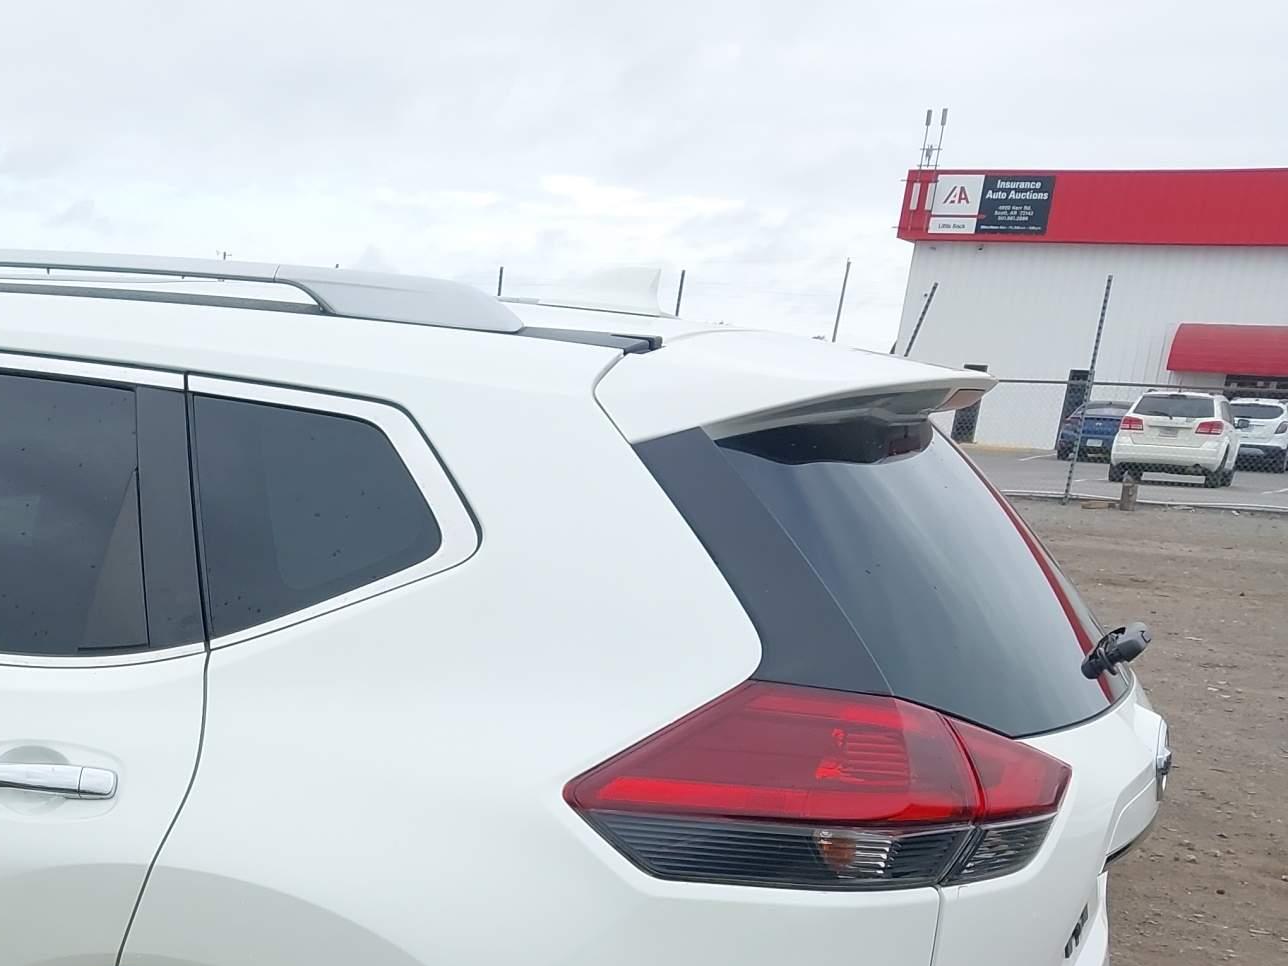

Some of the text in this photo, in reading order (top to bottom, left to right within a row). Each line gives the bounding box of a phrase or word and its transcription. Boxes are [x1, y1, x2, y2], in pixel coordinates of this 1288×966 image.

[997, 179, 1042, 189] Insurance
[985, 190, 1049, 200] Auto Auctions
